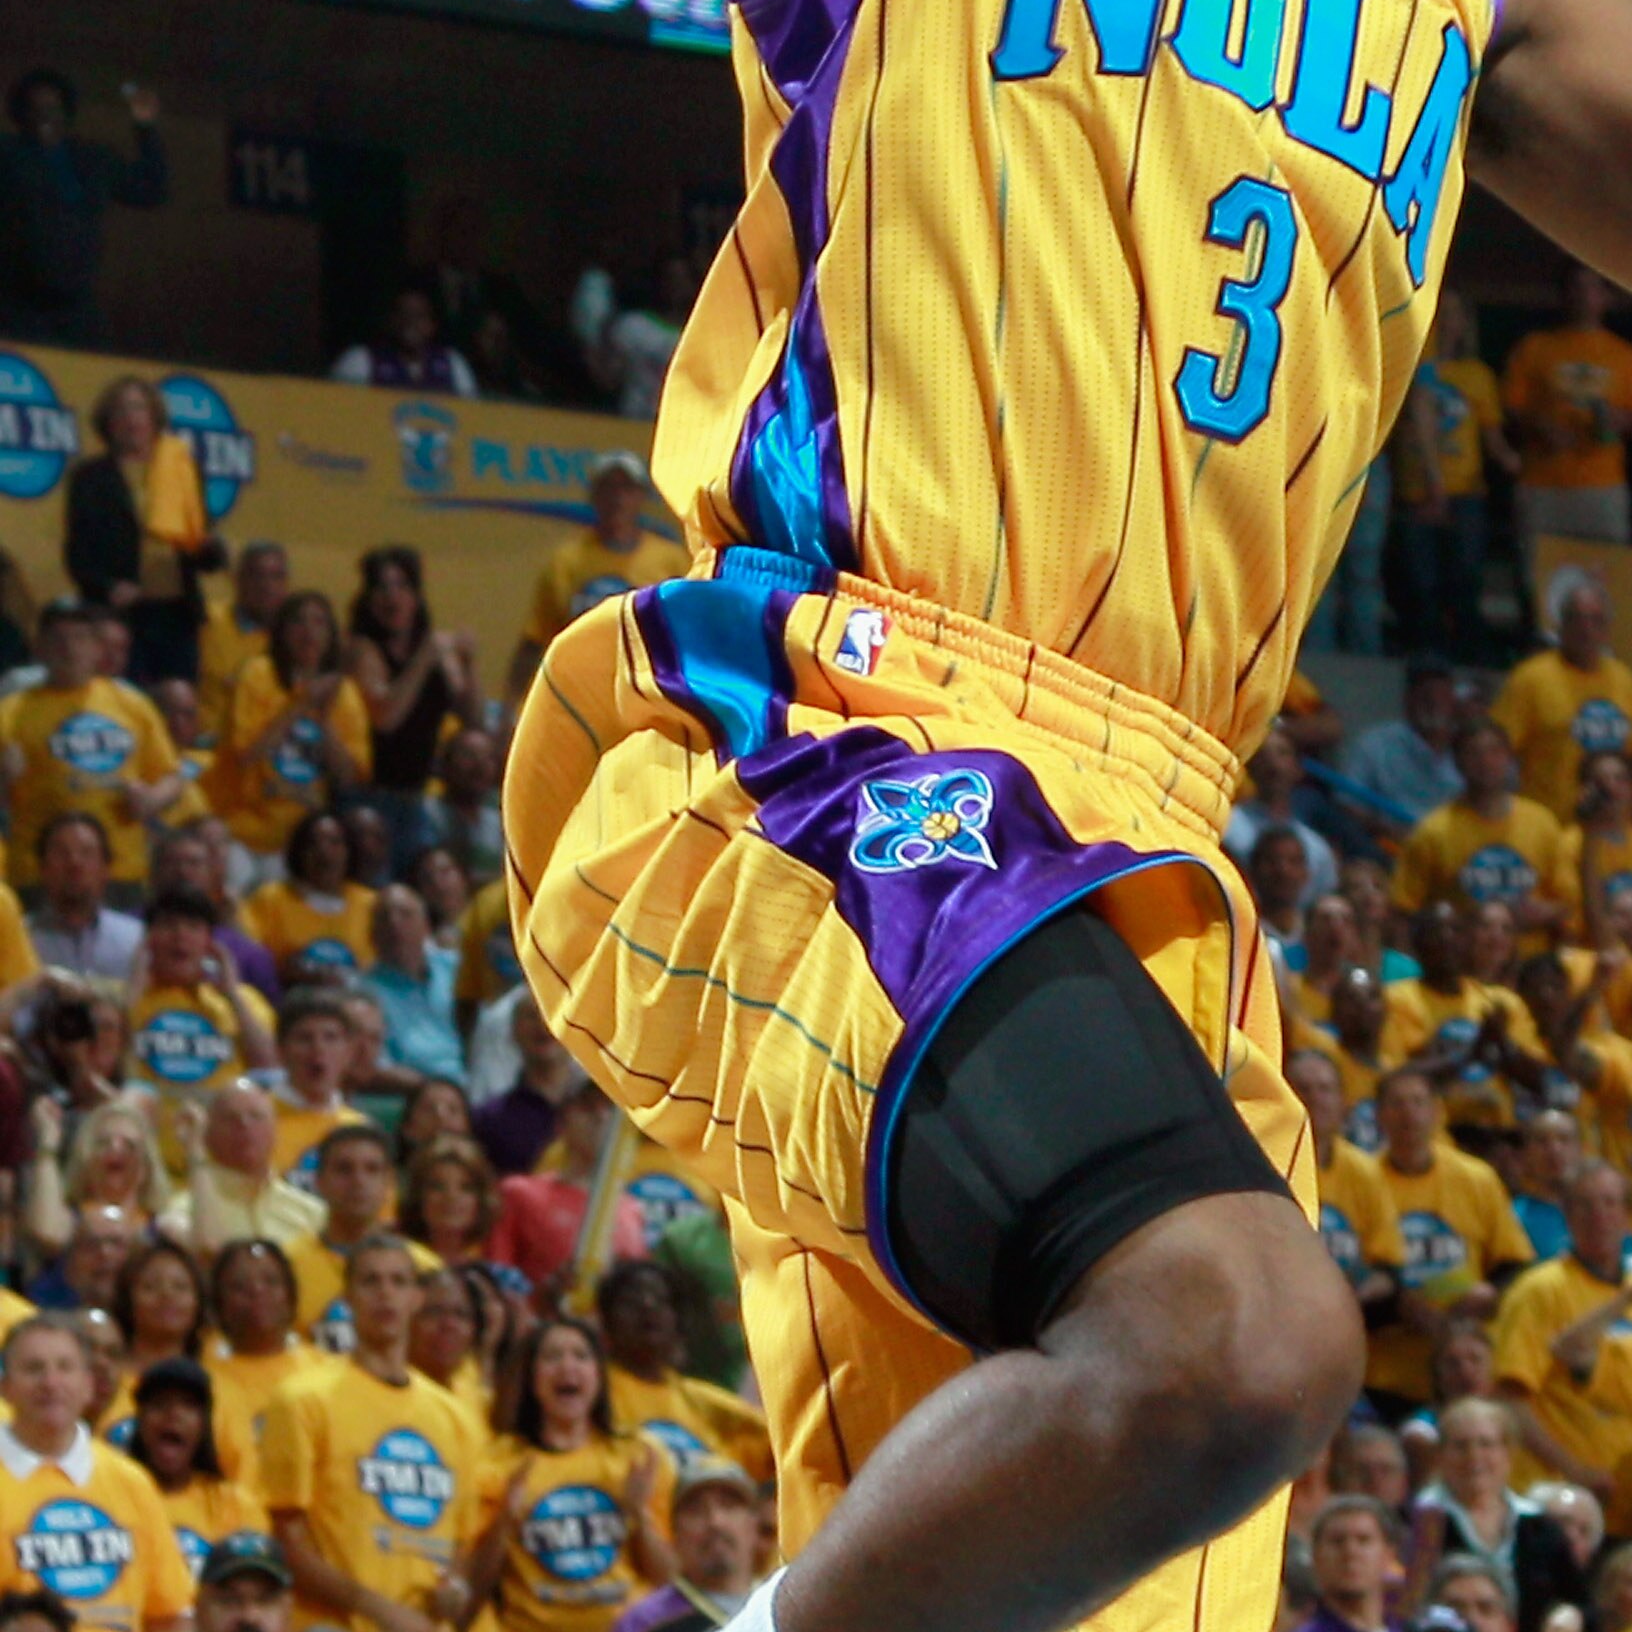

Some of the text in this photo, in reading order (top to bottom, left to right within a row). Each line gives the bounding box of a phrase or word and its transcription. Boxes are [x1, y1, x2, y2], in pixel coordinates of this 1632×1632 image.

[1172, 174, 1299, 446] 3
[16, 1527, 133, 1571] I'M IN
